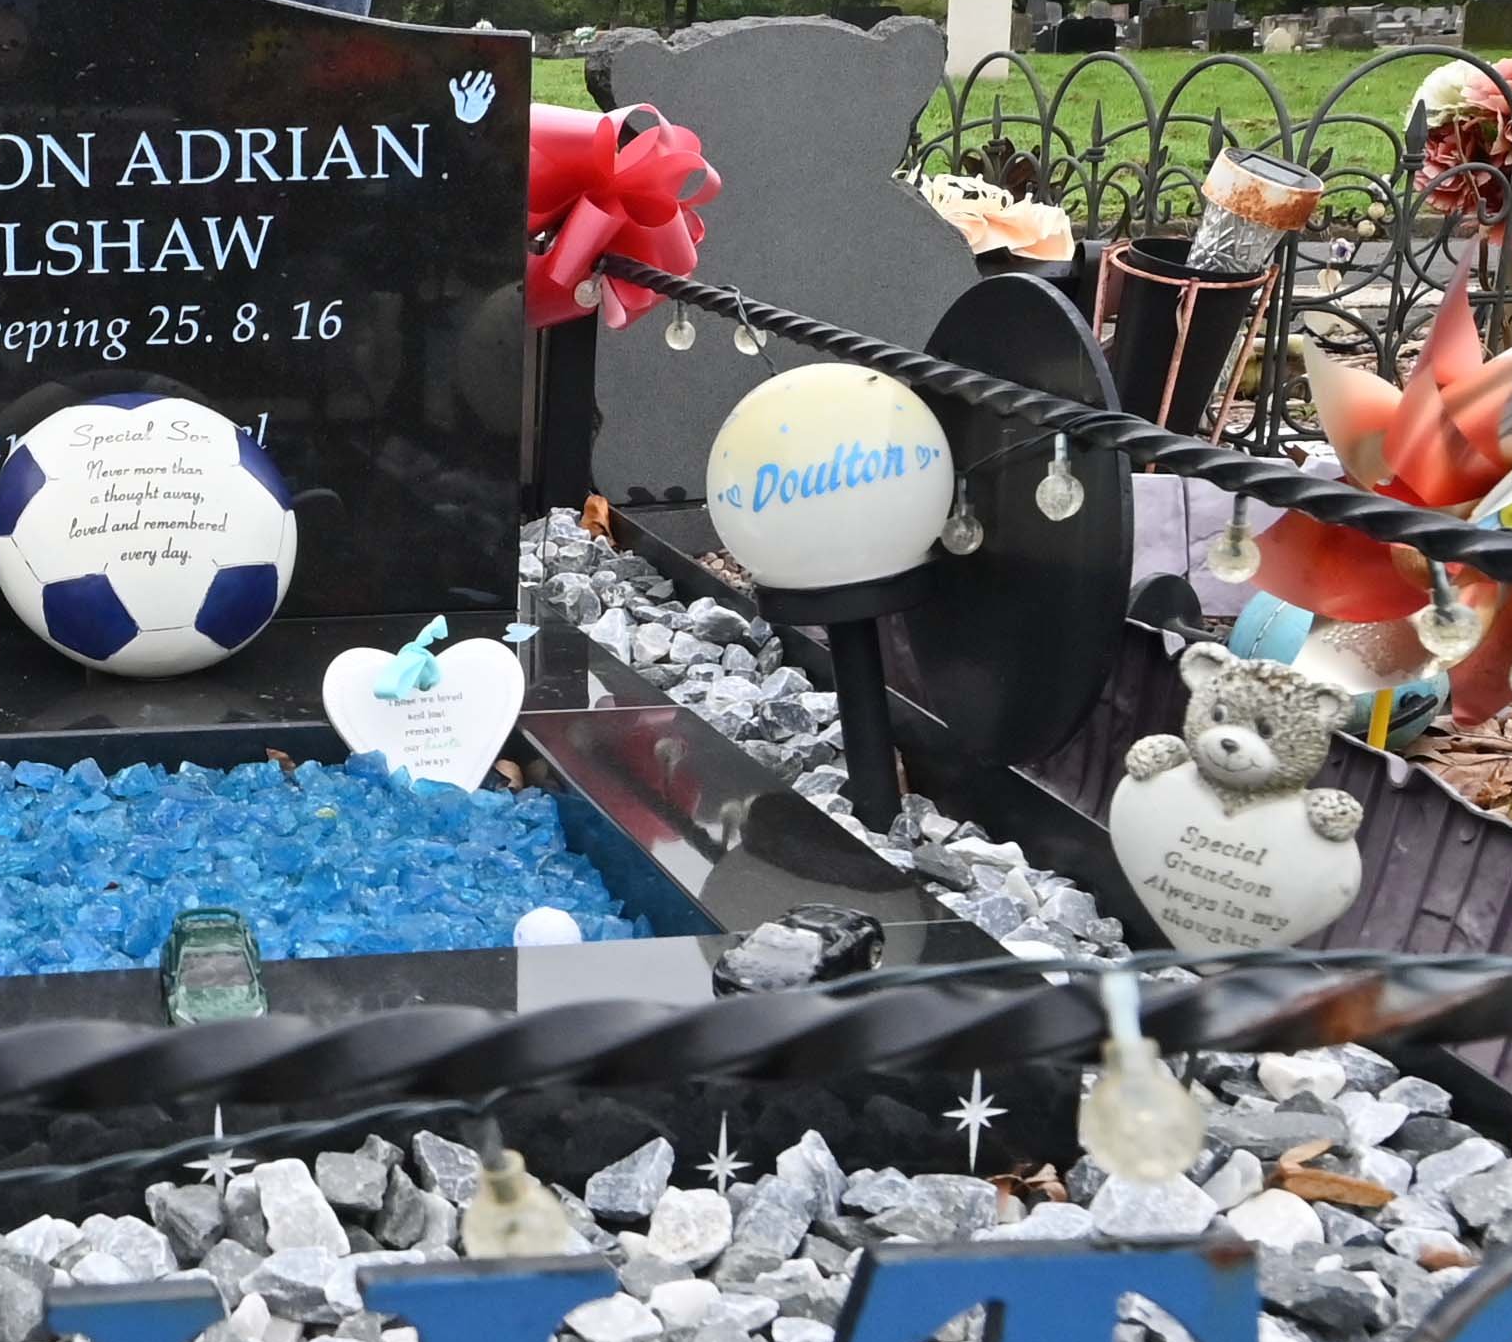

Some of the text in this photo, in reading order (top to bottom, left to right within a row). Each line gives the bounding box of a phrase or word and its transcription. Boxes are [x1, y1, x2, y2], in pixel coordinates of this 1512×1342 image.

[117, 124, 431, 186] ADRIAN
[145, 304, 213, 346] 25.
[232, 303, 270, 341] 8.
[291, 299, 343, 341] 16
[69, 421, 154, 450] Special
[86, 457, 204, 479] Never more than
[753, 441, 905, 512] Doulton
[90, 481, 204, 505] a thought away,
[69, 510, 228, 539] loved and remembered
[121, 536, 192, 566] every day.
[1180, 826, 1268, 866] Special
[1164, 851, 1272, 898] Grandson
[1143, 874, 1290, 931] Always in my
[1161, 908, 1261, 948] thoughts
